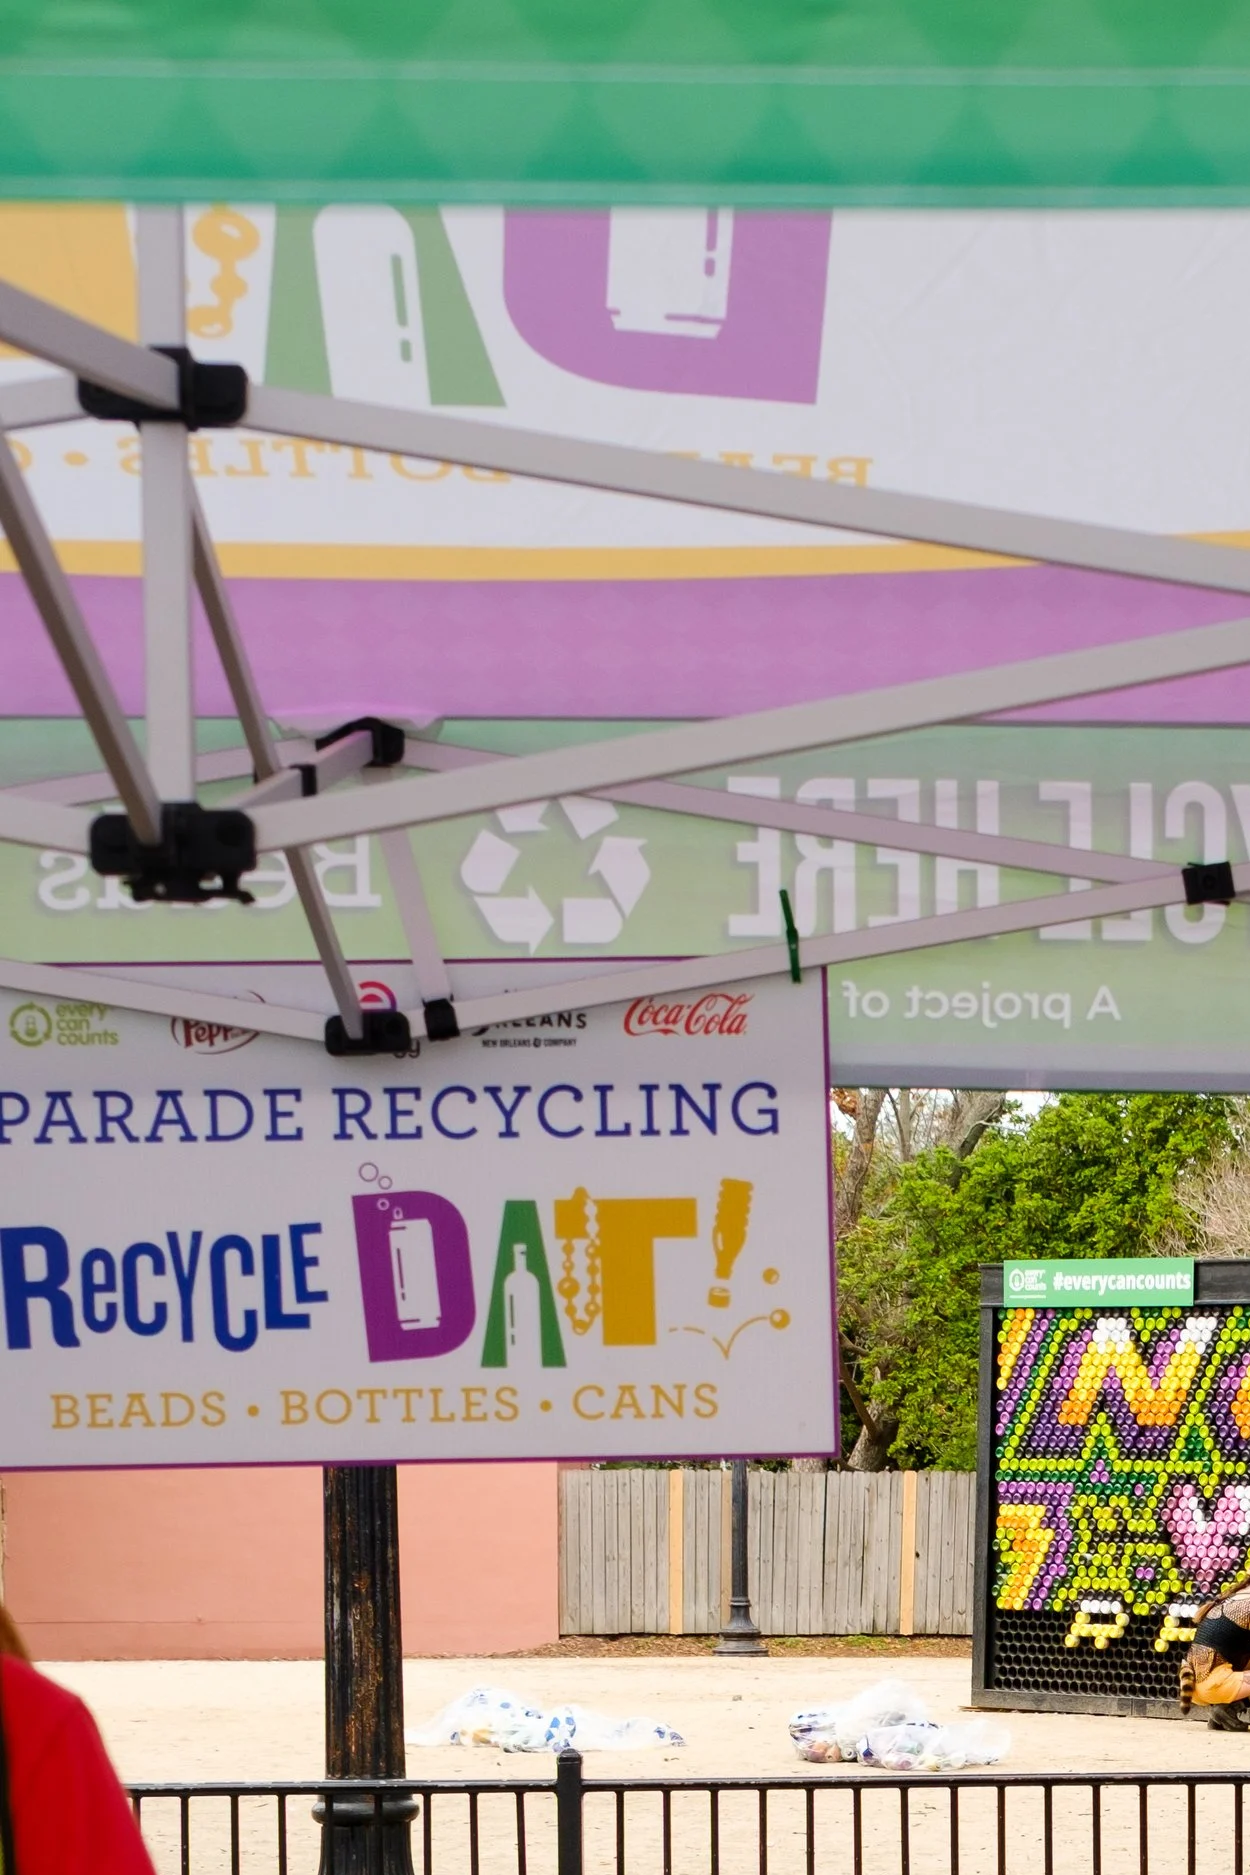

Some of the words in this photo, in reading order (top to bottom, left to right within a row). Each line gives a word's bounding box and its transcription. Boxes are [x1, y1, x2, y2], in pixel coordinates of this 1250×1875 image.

[55, 1002, 107, 1022] every
[623, 994, 755, 1038] Coca-Cola
[56, 1020, 91, 1032] can
[57, 1030, 119, 1047] counts
[543, 1037, 577, 1048] COMPANY
[0, 1088, 303, 1145] PARADE
[332, 1081, 780, 1142] RECYCLING
[1053, 1271, 1191, 1296] #everycancounts
[51, 1393, 227, 1430] BEADS
[280, 1387, 521, 1427] BOTTLES
[572, 1382, 720, 1422] CANS
